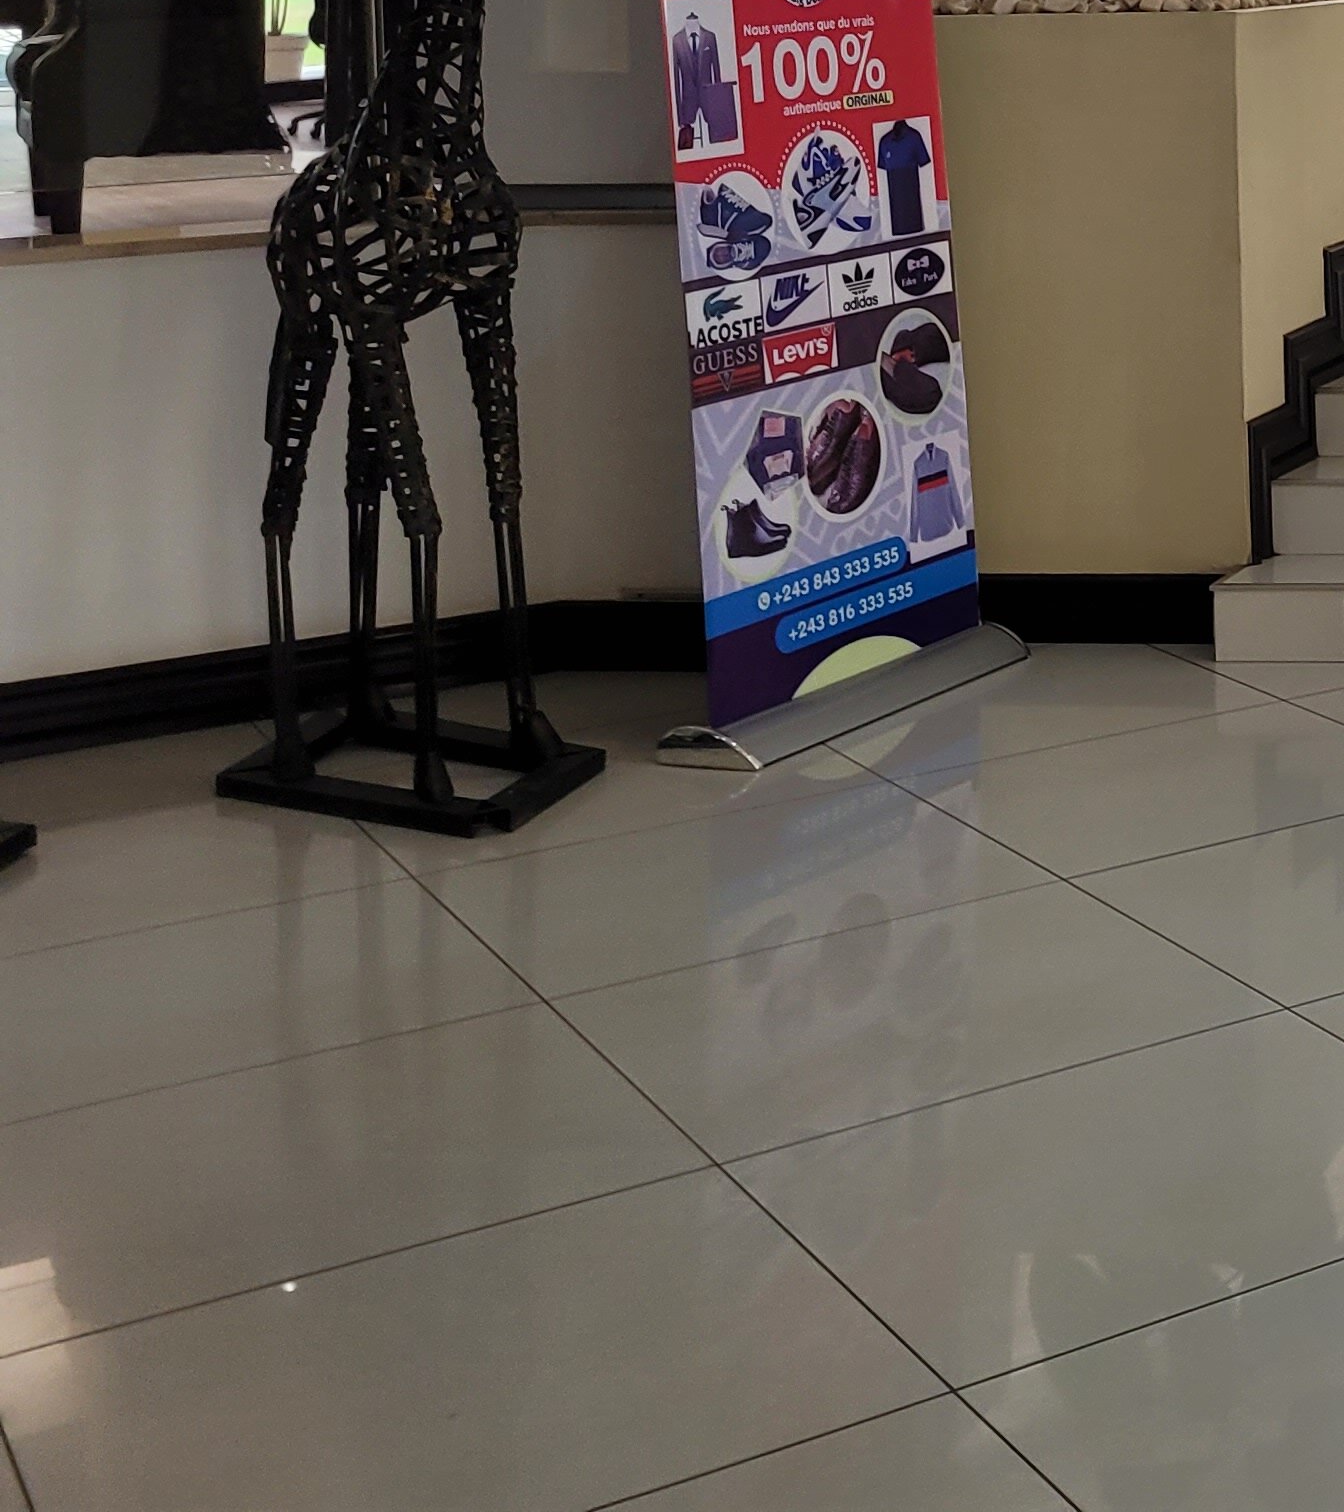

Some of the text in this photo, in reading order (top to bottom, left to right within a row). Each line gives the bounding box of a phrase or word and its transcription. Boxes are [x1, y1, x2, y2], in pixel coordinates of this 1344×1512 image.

[743, 14, 875, 36] Nous vendons que du vrais
[740, 30, 886, 104] 100%
[783, 91, 891, 117] authentique ORGINAL
[843, 295, 879, 312] adidas
[688, 315, 764, 349] LACOSTE
[693, 343, 758, 375] GUESS
[773, 546, 900, 605] +243 843 333 535
[788, 581, 913, 641] +243 816 333 535
